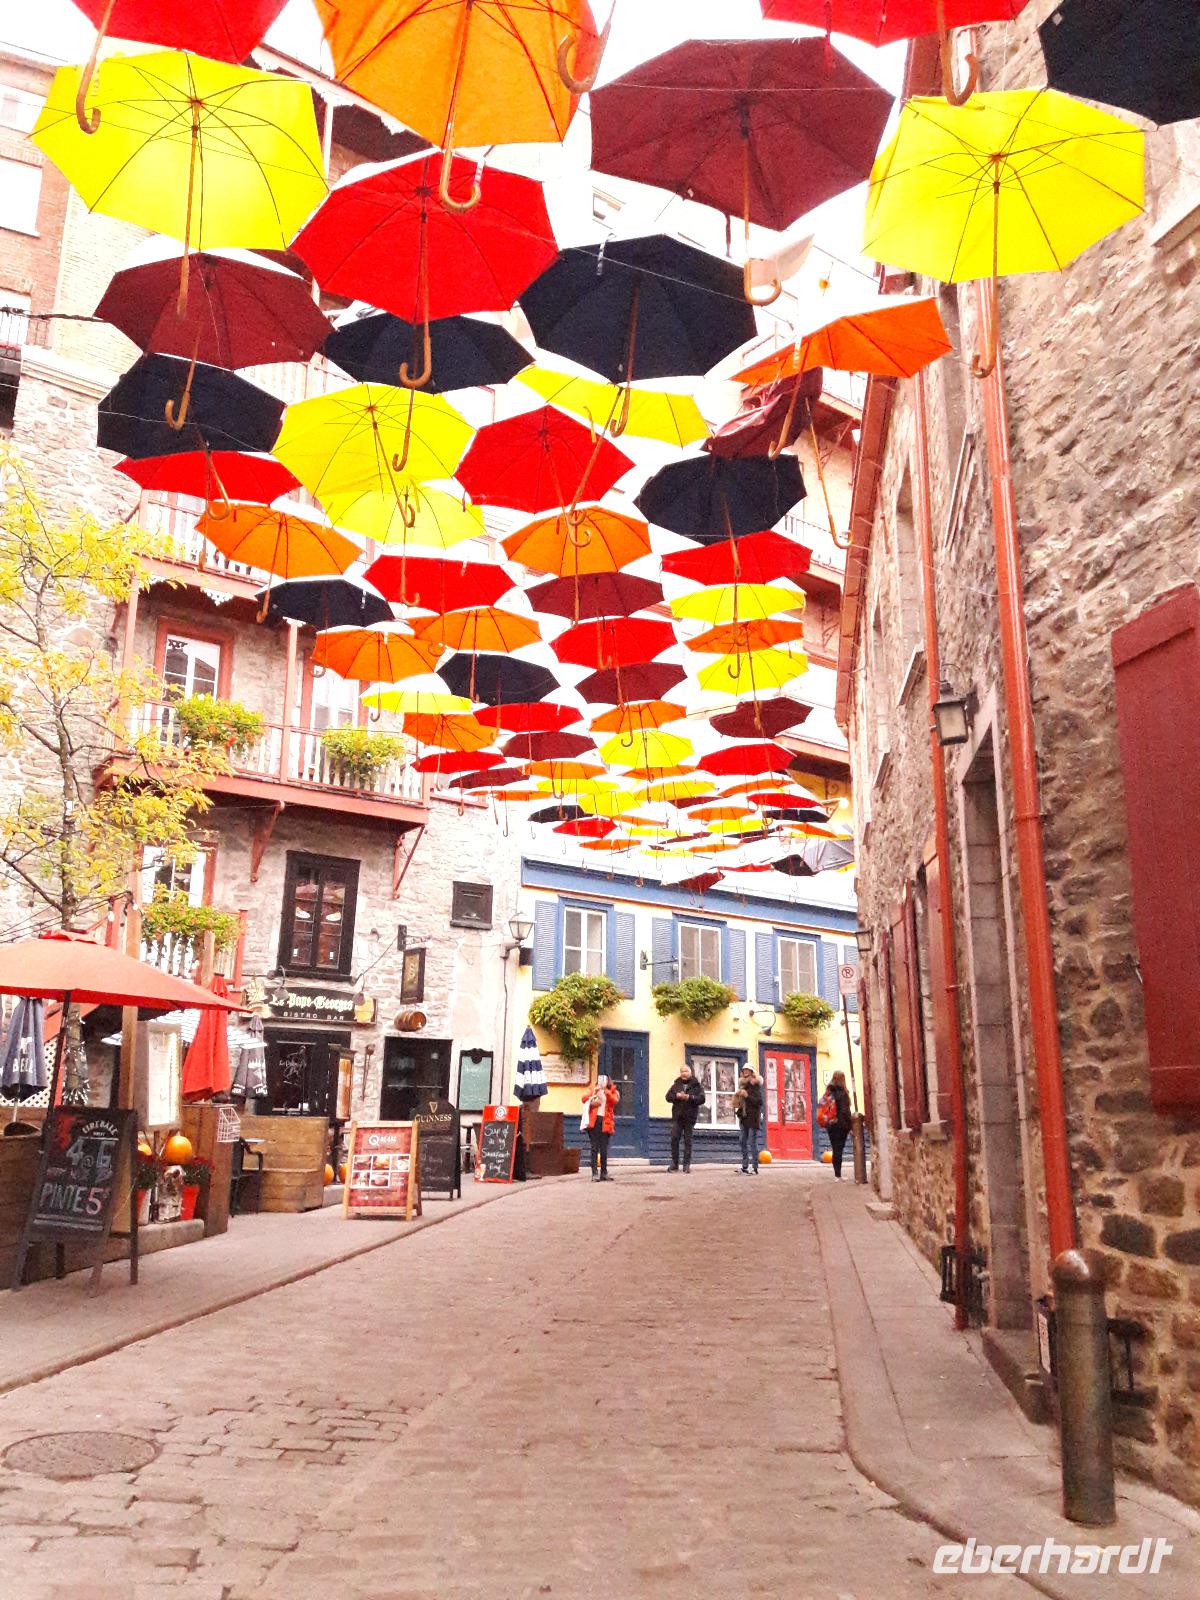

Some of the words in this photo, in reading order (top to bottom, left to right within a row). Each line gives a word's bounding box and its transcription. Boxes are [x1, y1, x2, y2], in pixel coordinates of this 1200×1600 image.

[283, 1011, 318, 1019] BISTRO
[415, 1113, 453, 1124] GUINNESS
[40, 1182, 88, 1213] PINTE
